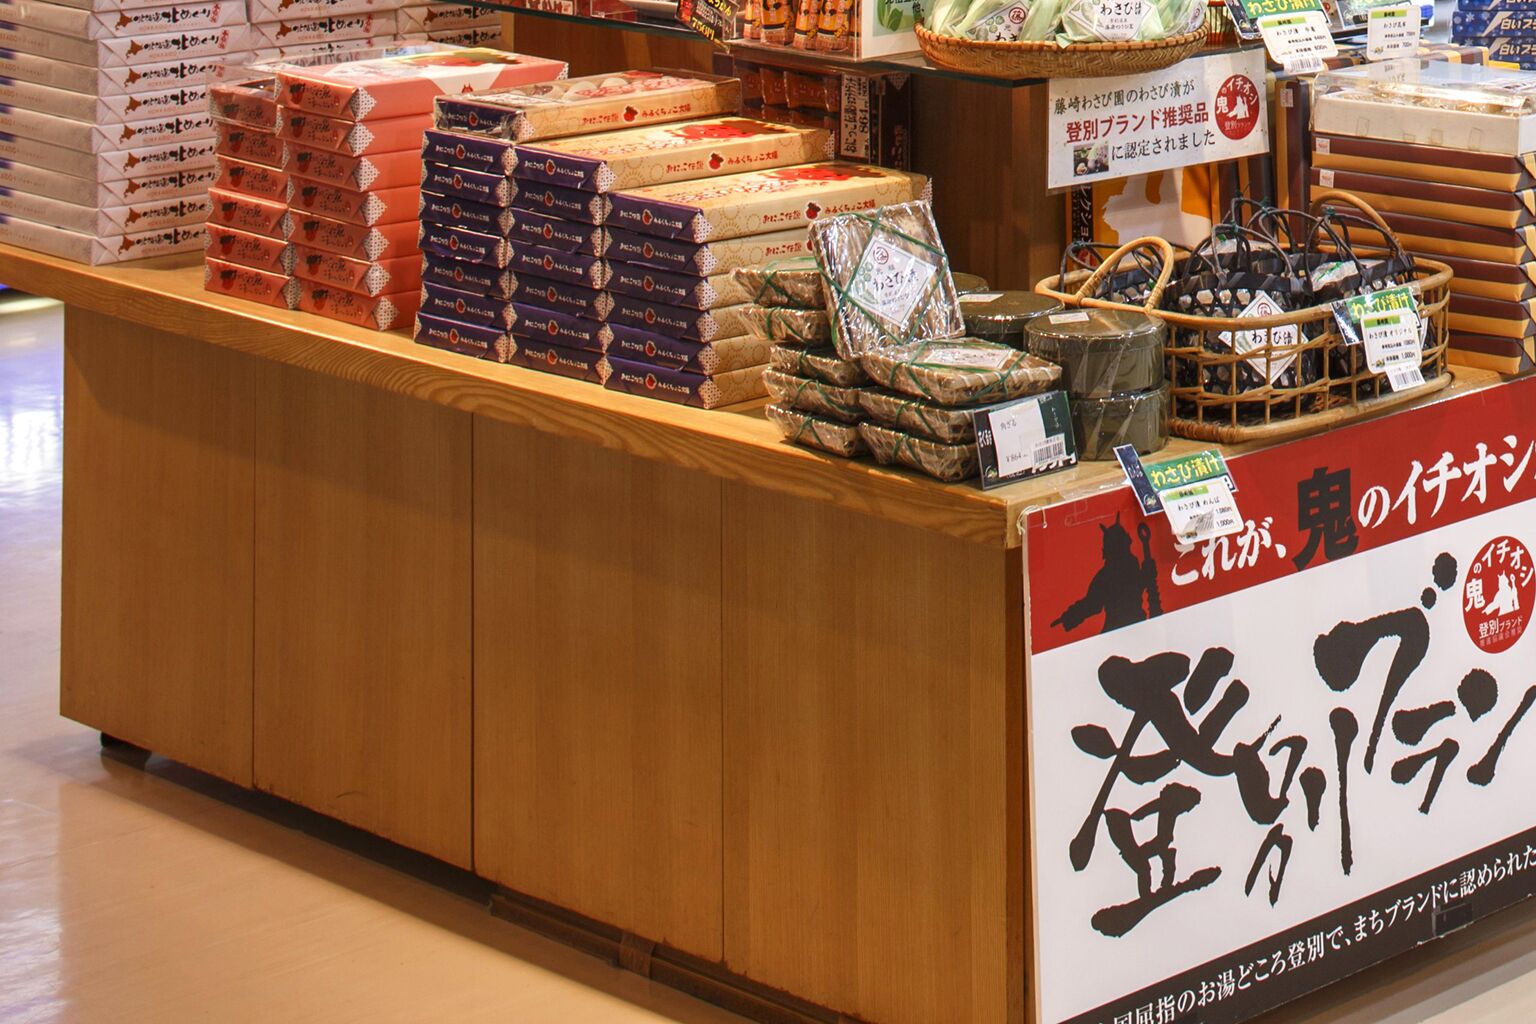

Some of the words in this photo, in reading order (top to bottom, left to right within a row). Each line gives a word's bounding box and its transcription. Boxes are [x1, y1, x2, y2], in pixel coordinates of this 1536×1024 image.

[1053, 79, 1195, 115] 藤崎わさび園のわさび漬が
[1066, 102, 1210, 144] 登別ブランド推奨品
[1111, 129, 1216, 161] に認定されました
[1151, 453, 1221, 487] わさび漬け
[1464, 539, 1534, 613] 鬼のイチオシ
[1478, 615, 1523, 639] 登別ブランド
